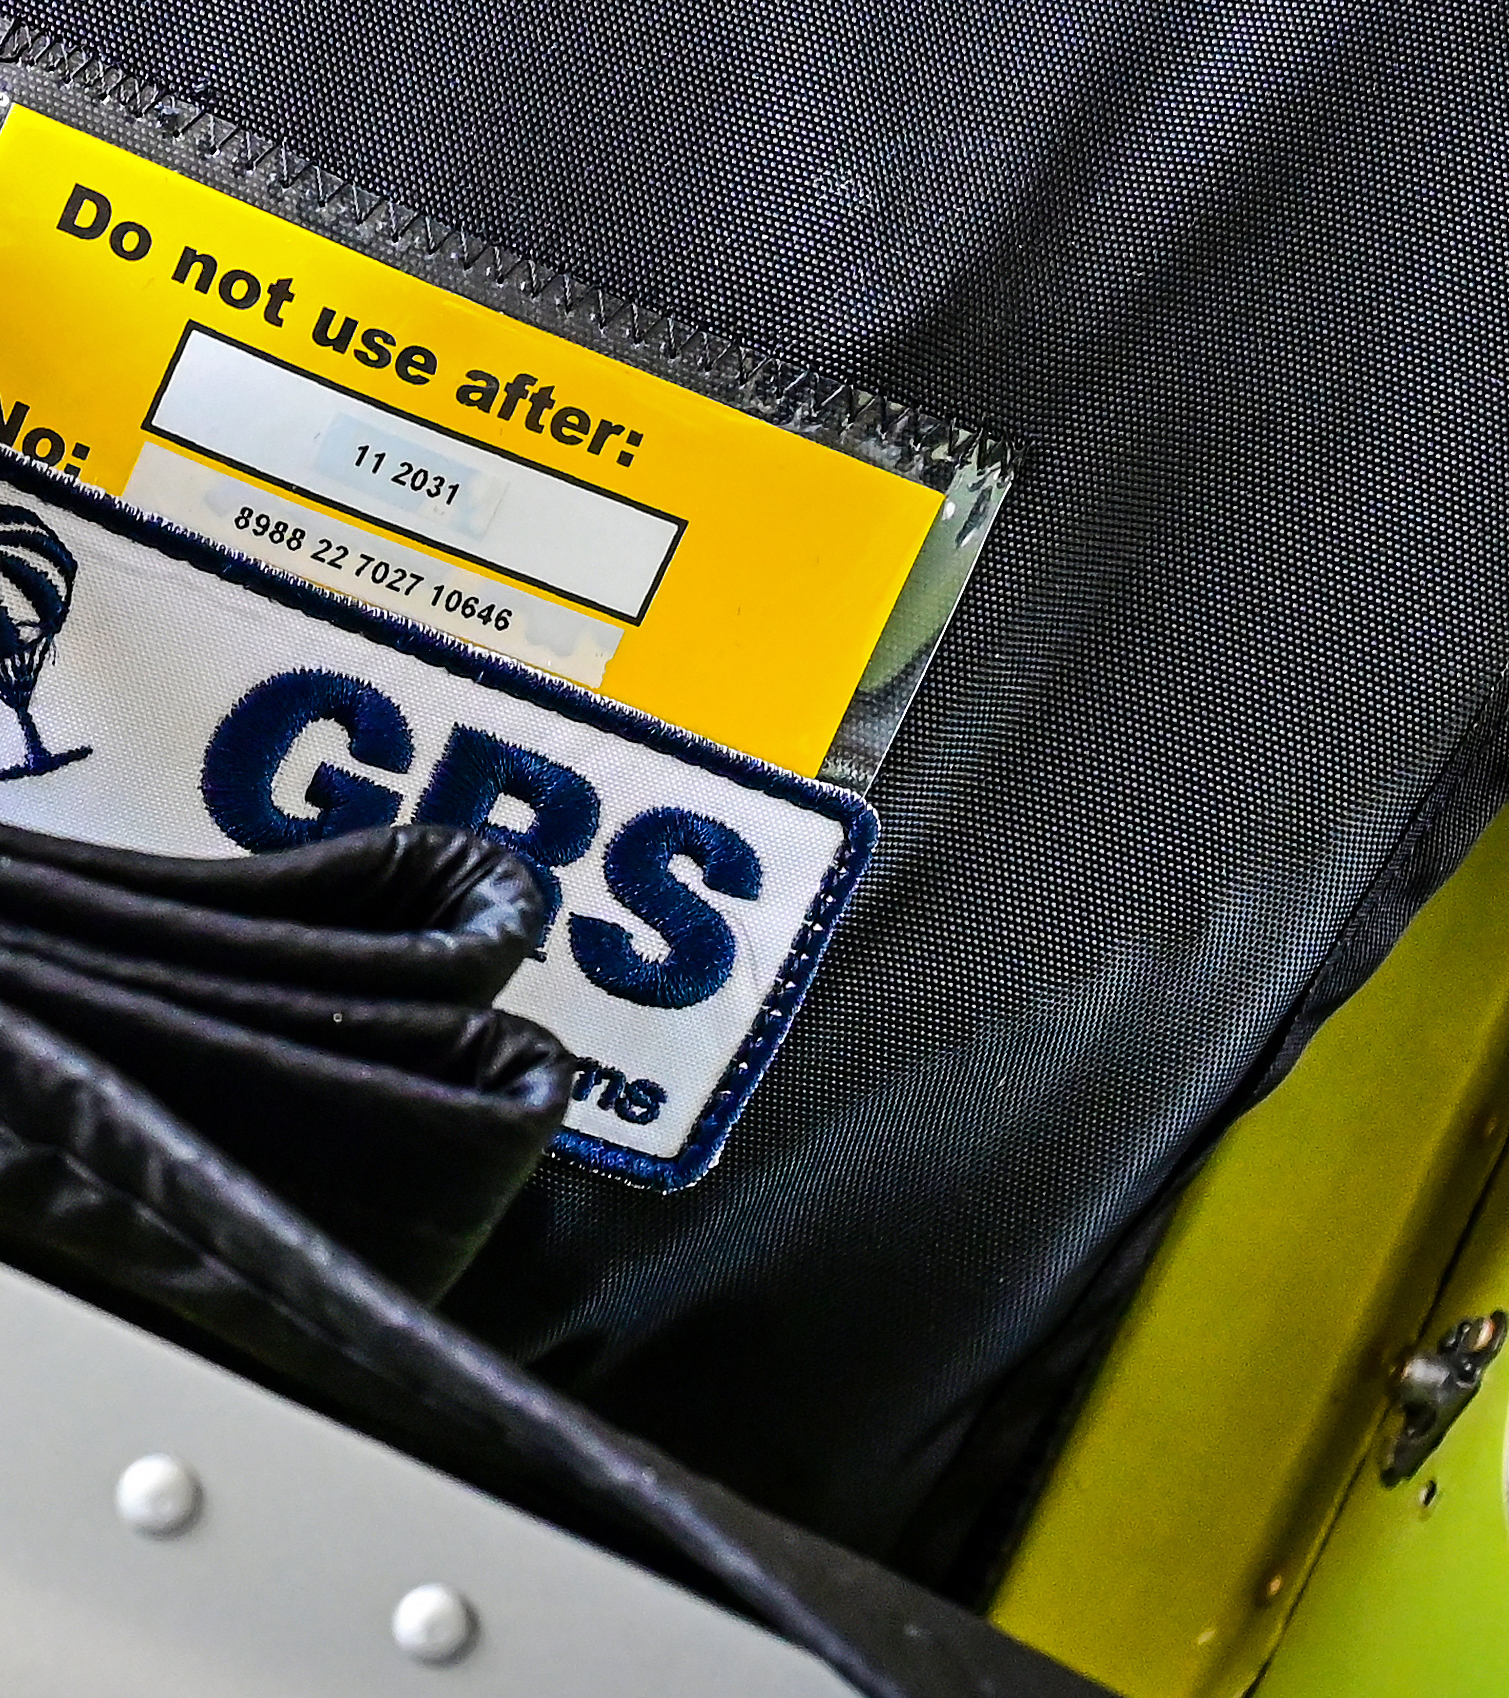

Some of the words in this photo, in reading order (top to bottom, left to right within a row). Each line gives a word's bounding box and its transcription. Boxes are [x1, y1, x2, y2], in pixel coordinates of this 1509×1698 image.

[55, 183, 152, 261] Do
[171, 245, 295, 328] not
[311, 305, 439, 385] use
[454, 368, 645, 468] after:
[354, 444, 387, 474] 11
[390, 461, 460, 505] 2031
[234, 506, 306, 551] 8988
[310, 538, 348, 570] 22
[354, 552, 425, 596] 7027
[431, 583, 513, 631] 10646
